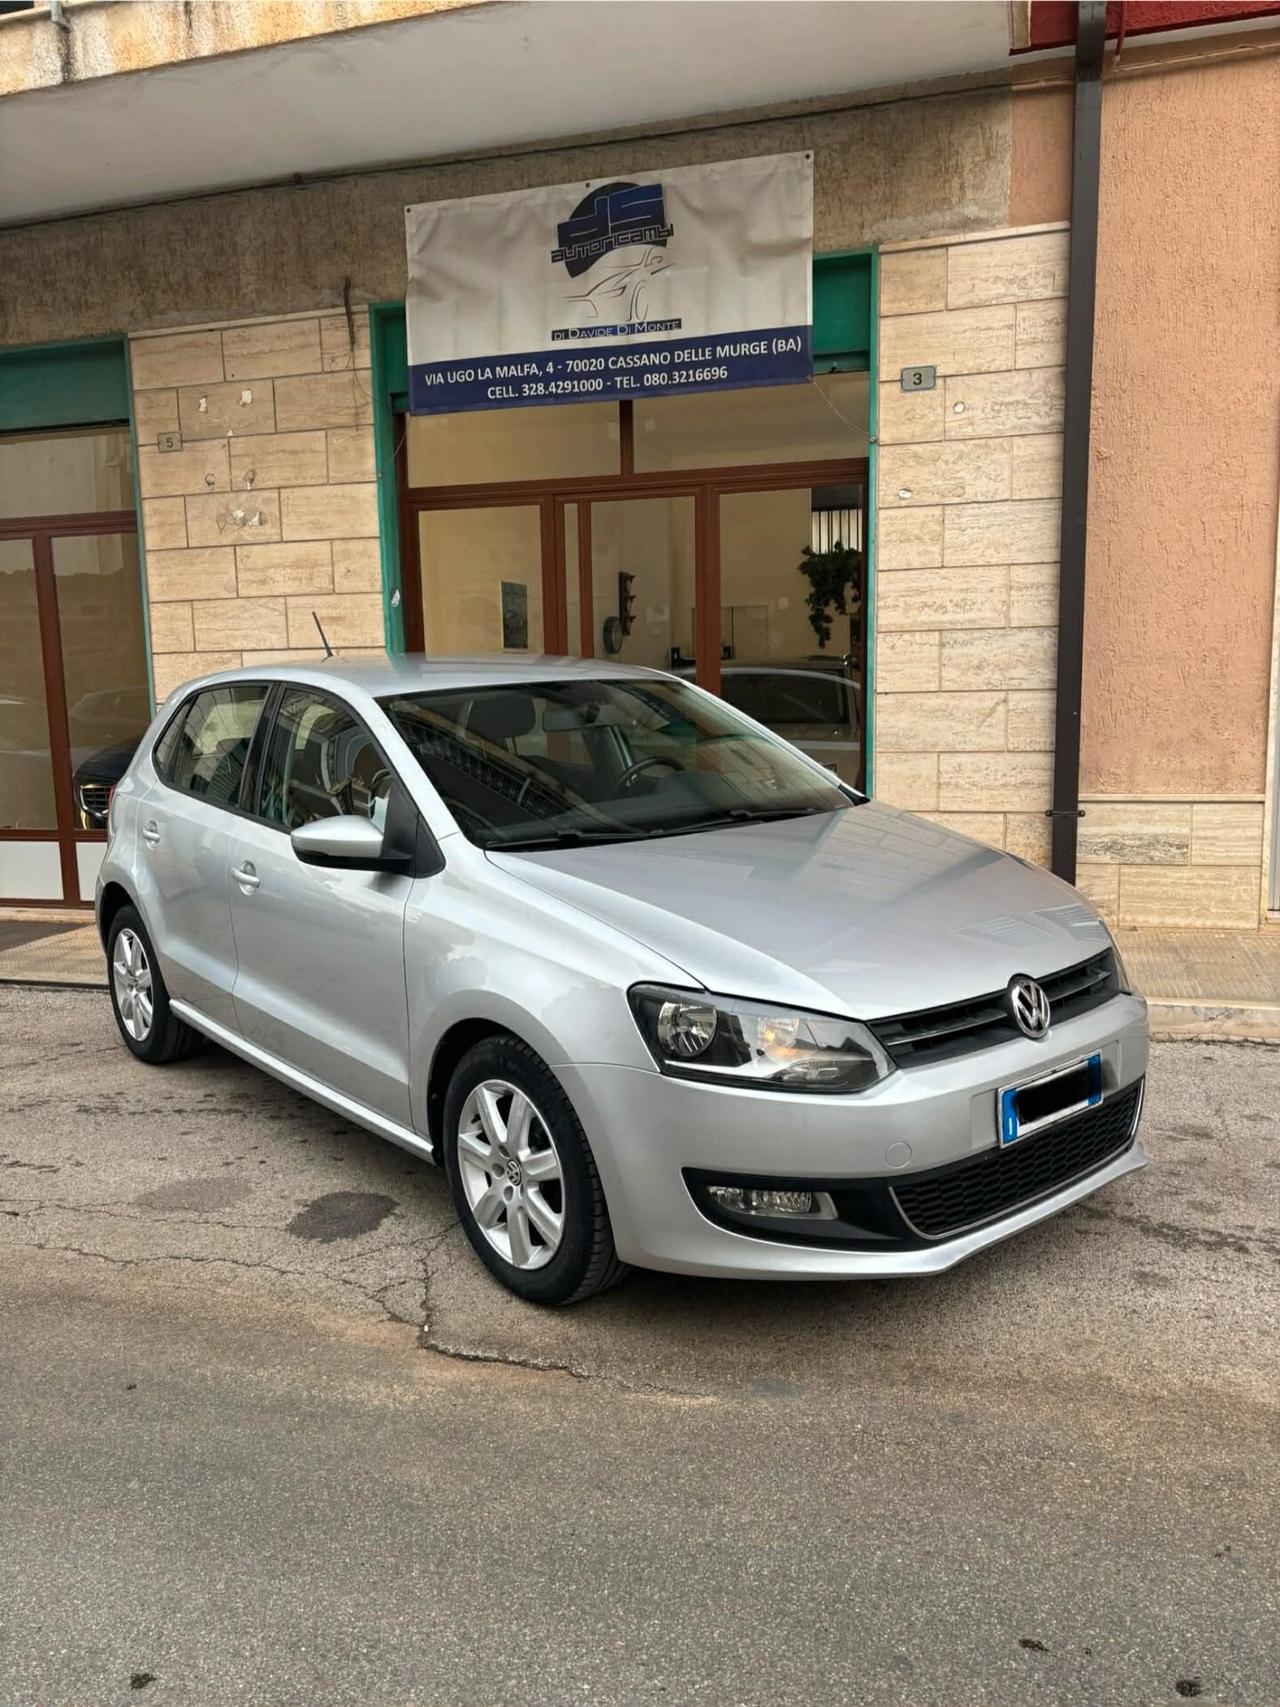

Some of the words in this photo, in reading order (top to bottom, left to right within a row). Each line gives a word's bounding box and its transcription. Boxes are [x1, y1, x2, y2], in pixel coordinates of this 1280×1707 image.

[425, 372, 444, 386] VIA
[447, 369, 475, 384] UGO
[478, 367, 493, 380] LA
[496, 362, 543, 378] MALFA,
[546, 361, 555, 374] 4
[566, 357, 605, 373] 70020
[608, 351, 671, 370] CASSANO
[674, 348, 713, 363] DELLE
[716, 340, 769, 359] MURGE
[772, 335, 802, 355] (BA)
[487, 384, 519, 399] CELL.
[522, 378, 603, 397] 328.4291000
[614, 374, 641, 389] TEL.
[643, 365, 729, 387] 080.3216696
[912, 372, 923, 386] 3
[166, 436, 174, 449] 5
